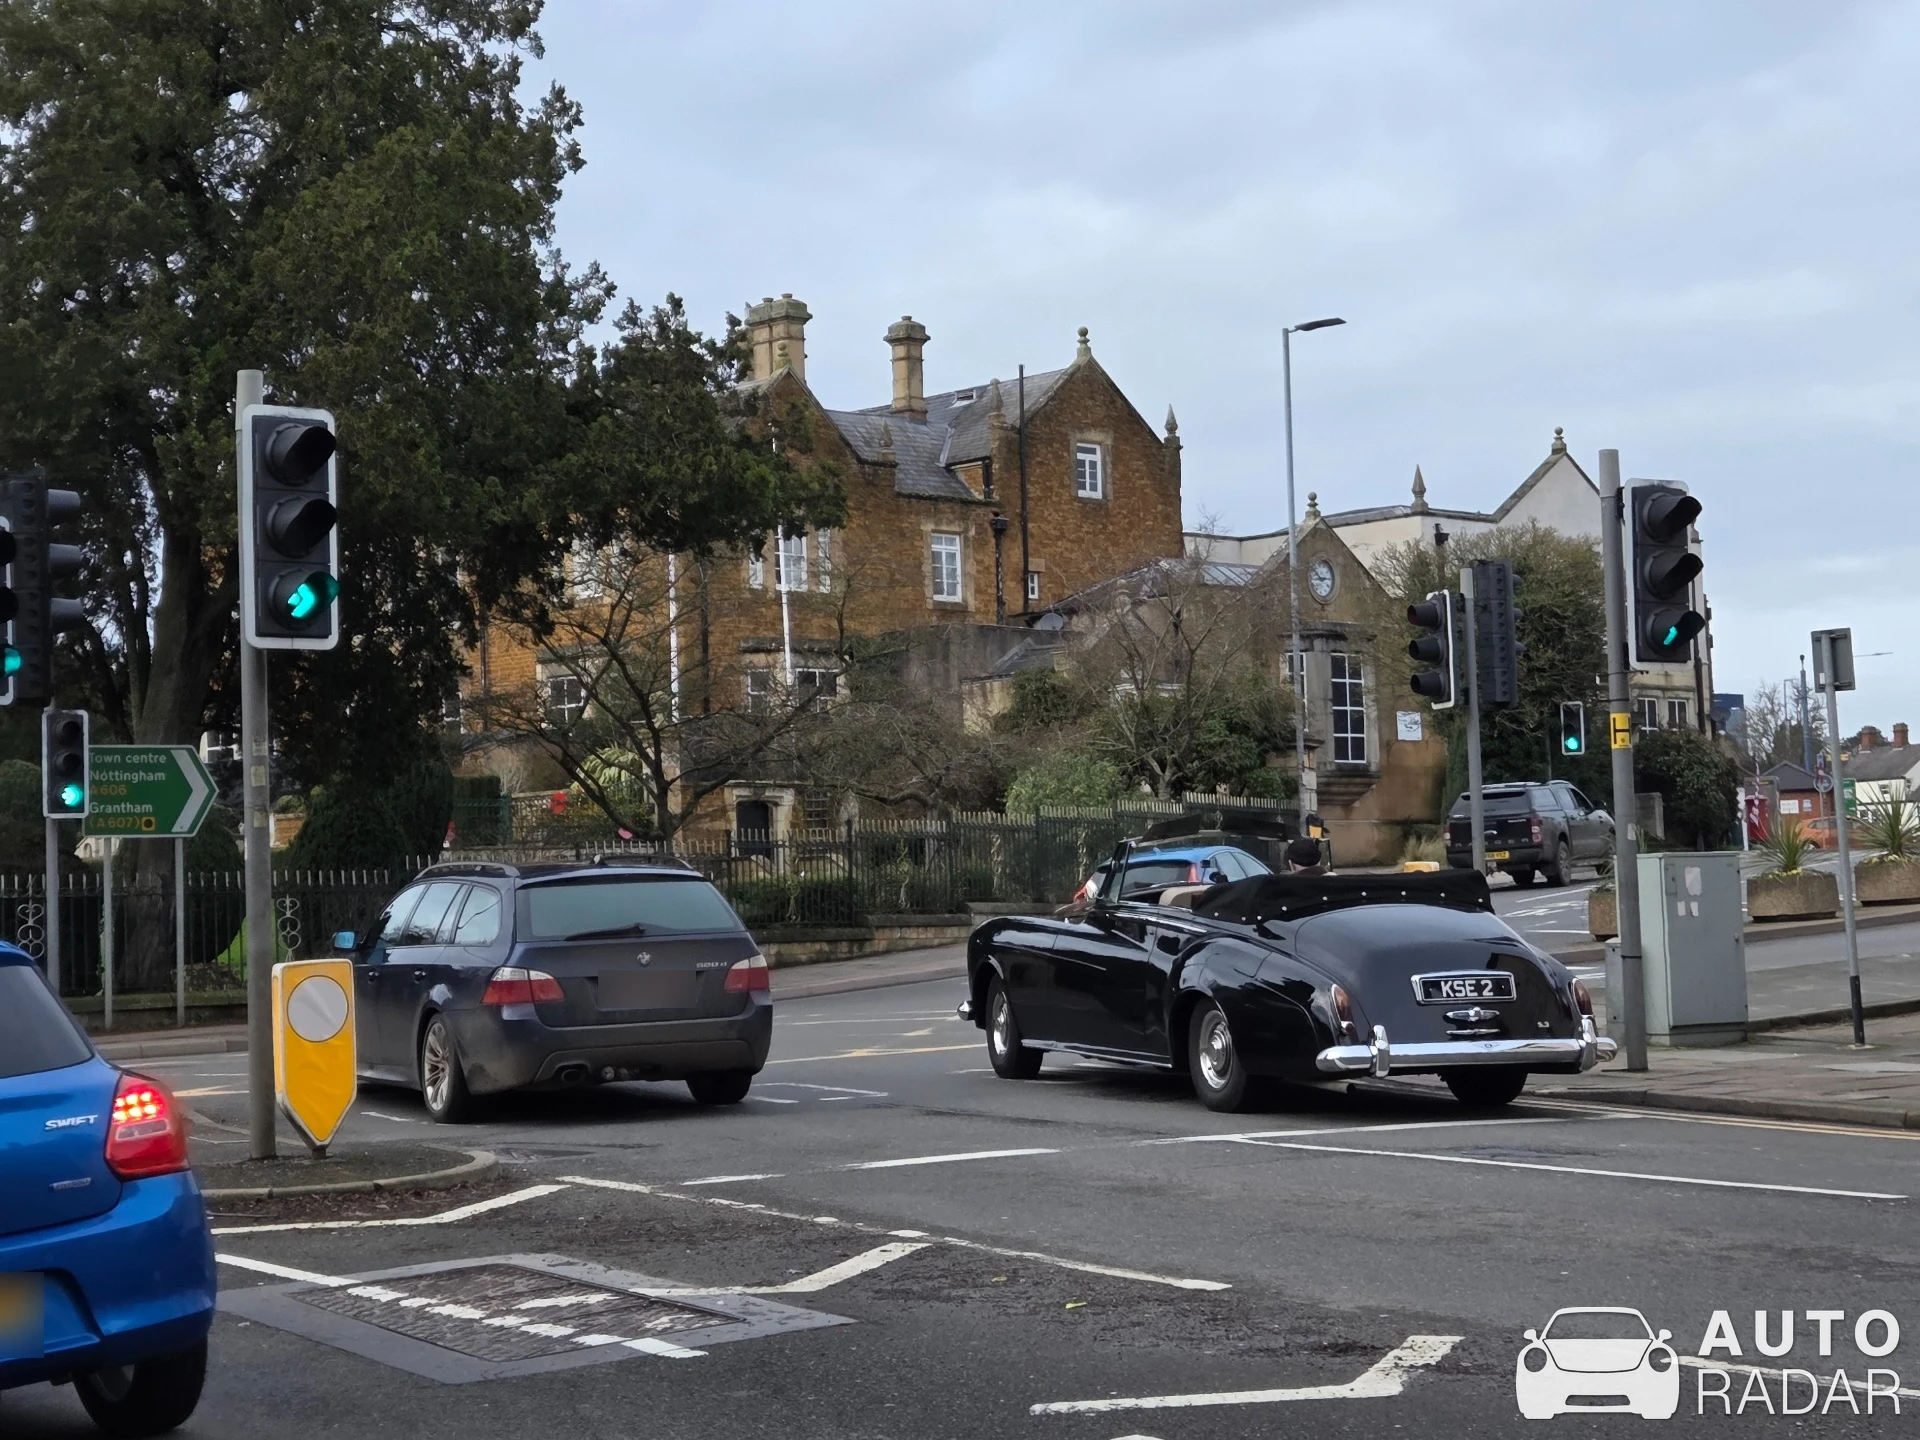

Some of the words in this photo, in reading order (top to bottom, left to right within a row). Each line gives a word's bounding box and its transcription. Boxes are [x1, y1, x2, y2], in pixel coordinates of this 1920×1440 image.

[89, 752, 121, 764] Town
[125, 752, 167, 764] centre
[89, 769, 166, 784] Nottingham
[89, 801, 153, 814] Grantham
[1441, 980, 1478, 998] KSE
[1480, 980, 1494, 997] 2
[44, 1114, 98, 1130] SWIFT
